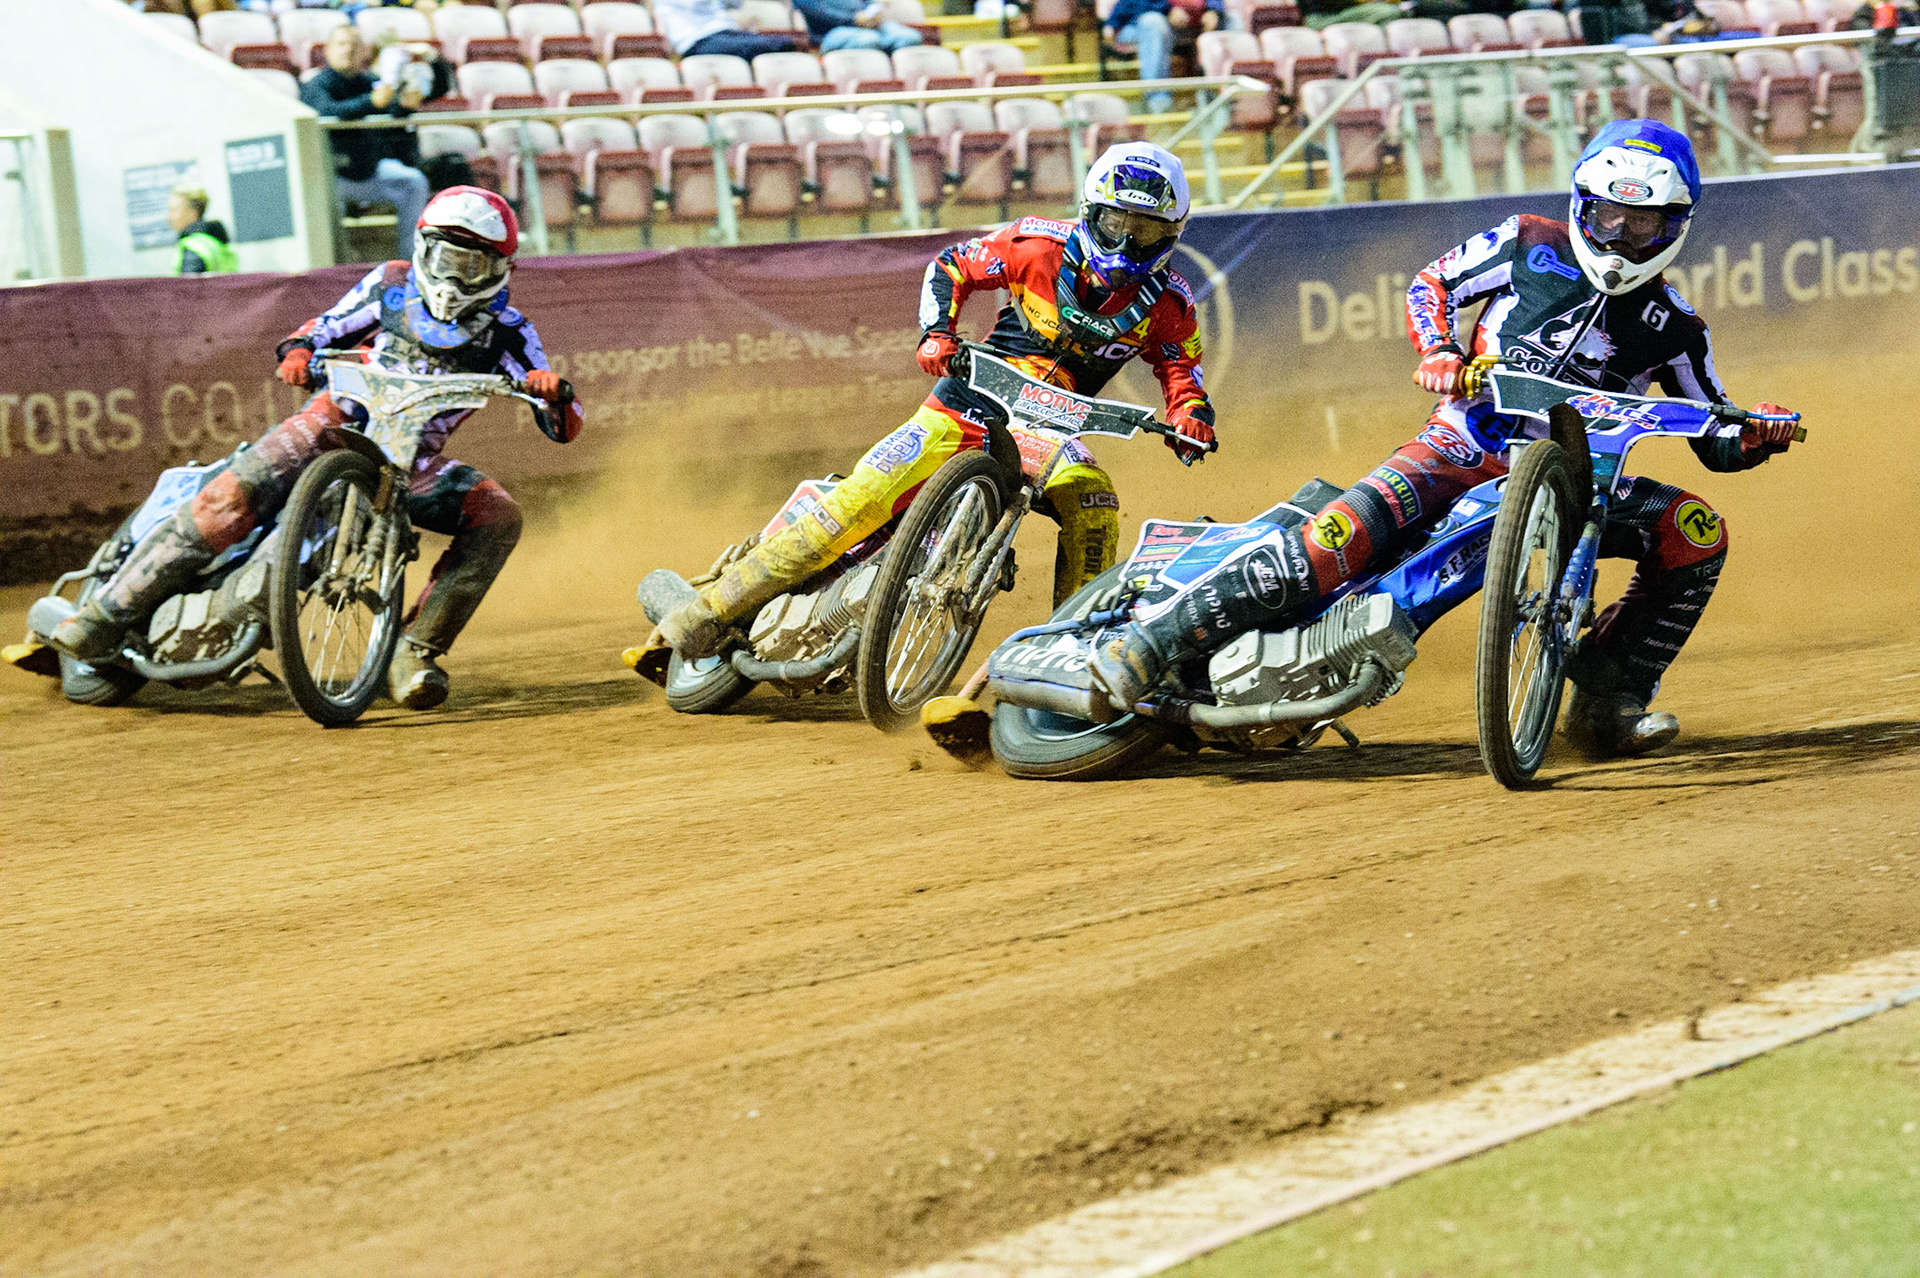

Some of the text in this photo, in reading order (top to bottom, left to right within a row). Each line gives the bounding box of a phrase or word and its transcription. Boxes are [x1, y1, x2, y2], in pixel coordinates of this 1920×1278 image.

[1116, 191, 1153, 203] Arai
[1298, 273, 1408, 344] Deli
[1663, 242, 1764, 309] orld
[1783, 237, 1919, 303] Class
[1133, 317, 1151, 340] 4
[573, 344, 680, 382] sponsor
[687, 334, 731, 368] the
[736, 330, 801, 365] Belle
[801, 330, 852, 359] Vue
[853, 325, 919, 358] Spee
[1020, 383, 1092, 421] MOTIVE
[875, 424, 929, 475] DISPLAY
[1081, 493, 1119, 508] JCB
[1373, 468, 1417, 517] BARRIER
